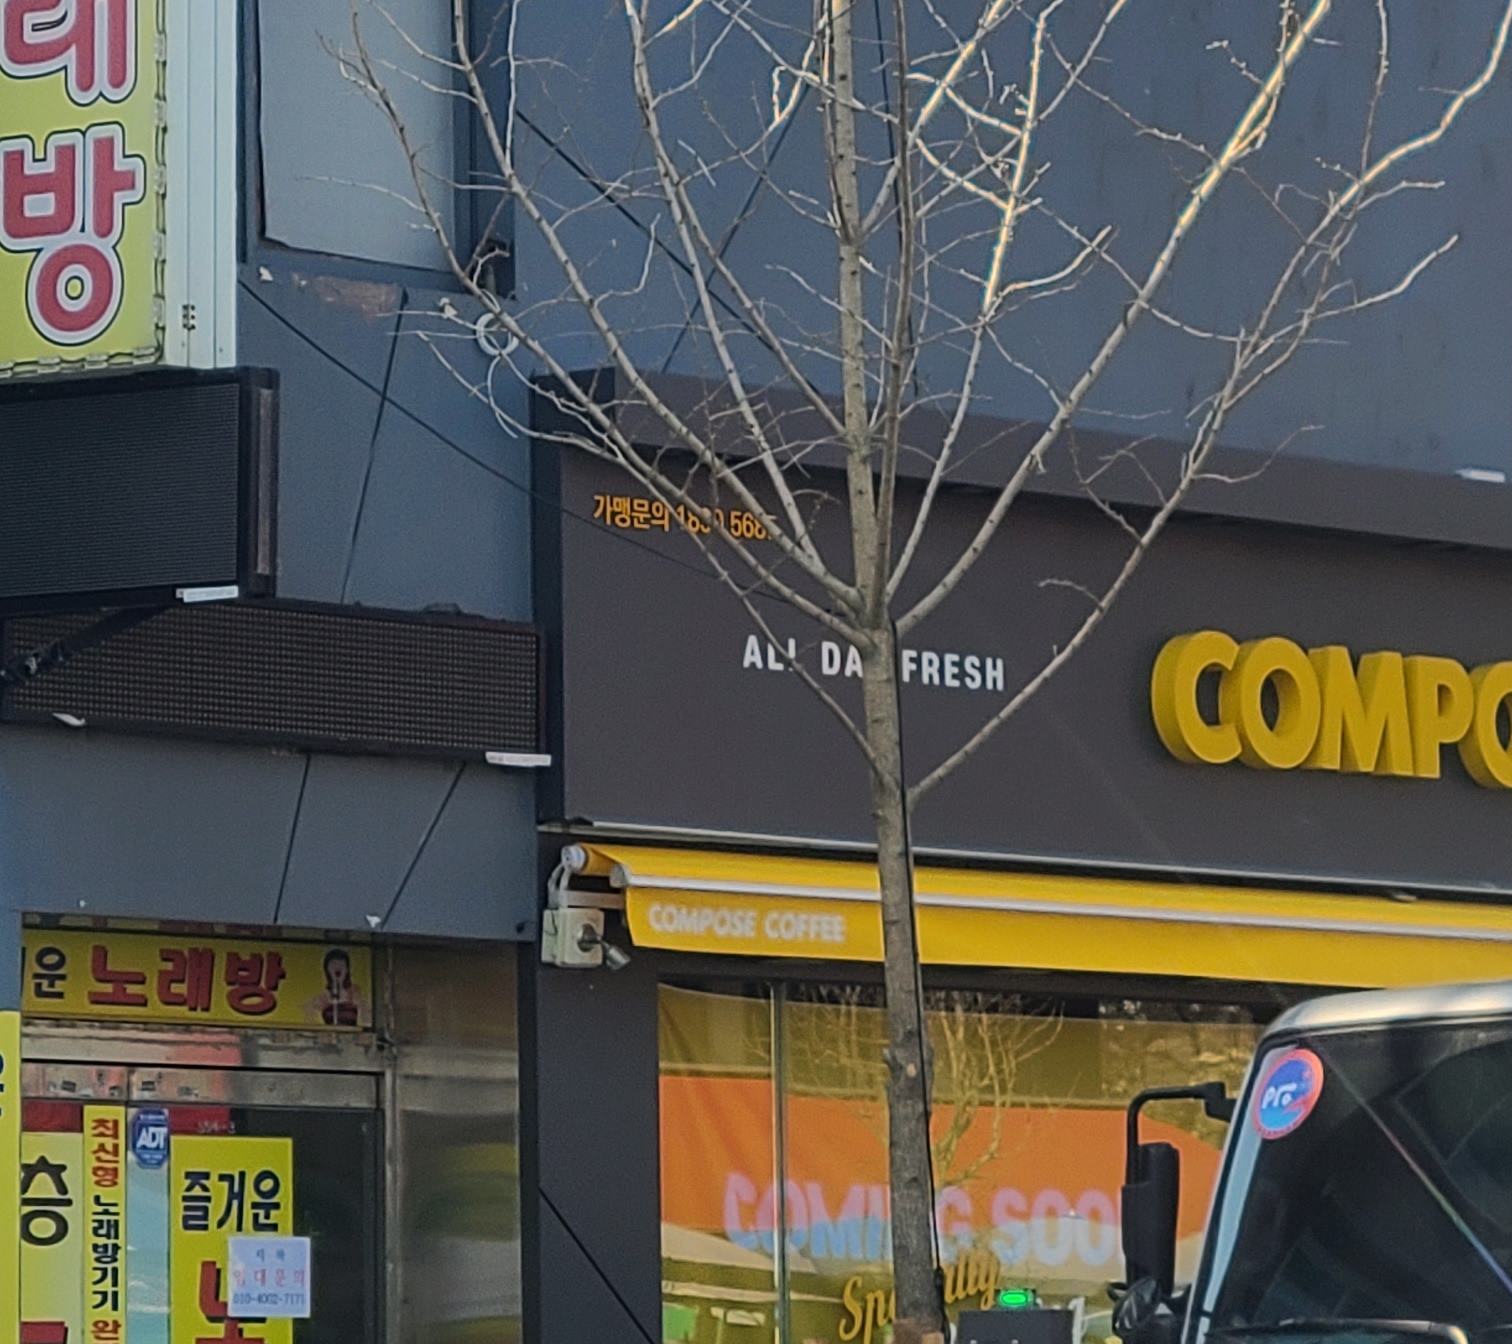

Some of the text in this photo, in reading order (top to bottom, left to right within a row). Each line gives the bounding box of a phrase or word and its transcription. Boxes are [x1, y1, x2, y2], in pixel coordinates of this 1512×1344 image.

[594, 495, 669, 532] 가맹문의
[822, 641, 863, 678] DA
[902, 649, 1004, 691] FRESH
[649, 905, 846, 943] COMPOSE COFFEE
[87, 945, 286, 1016] 노래방
[90, 1118, 120, 1188] 최신형
[136, 1127, 168, 1149] ADT
[181, 1169, 281, 1232] 즐거운
[723, 1172, 1121, 1266] COMIG SOO
[90, 1194, 121, 1312] 노래방기기
